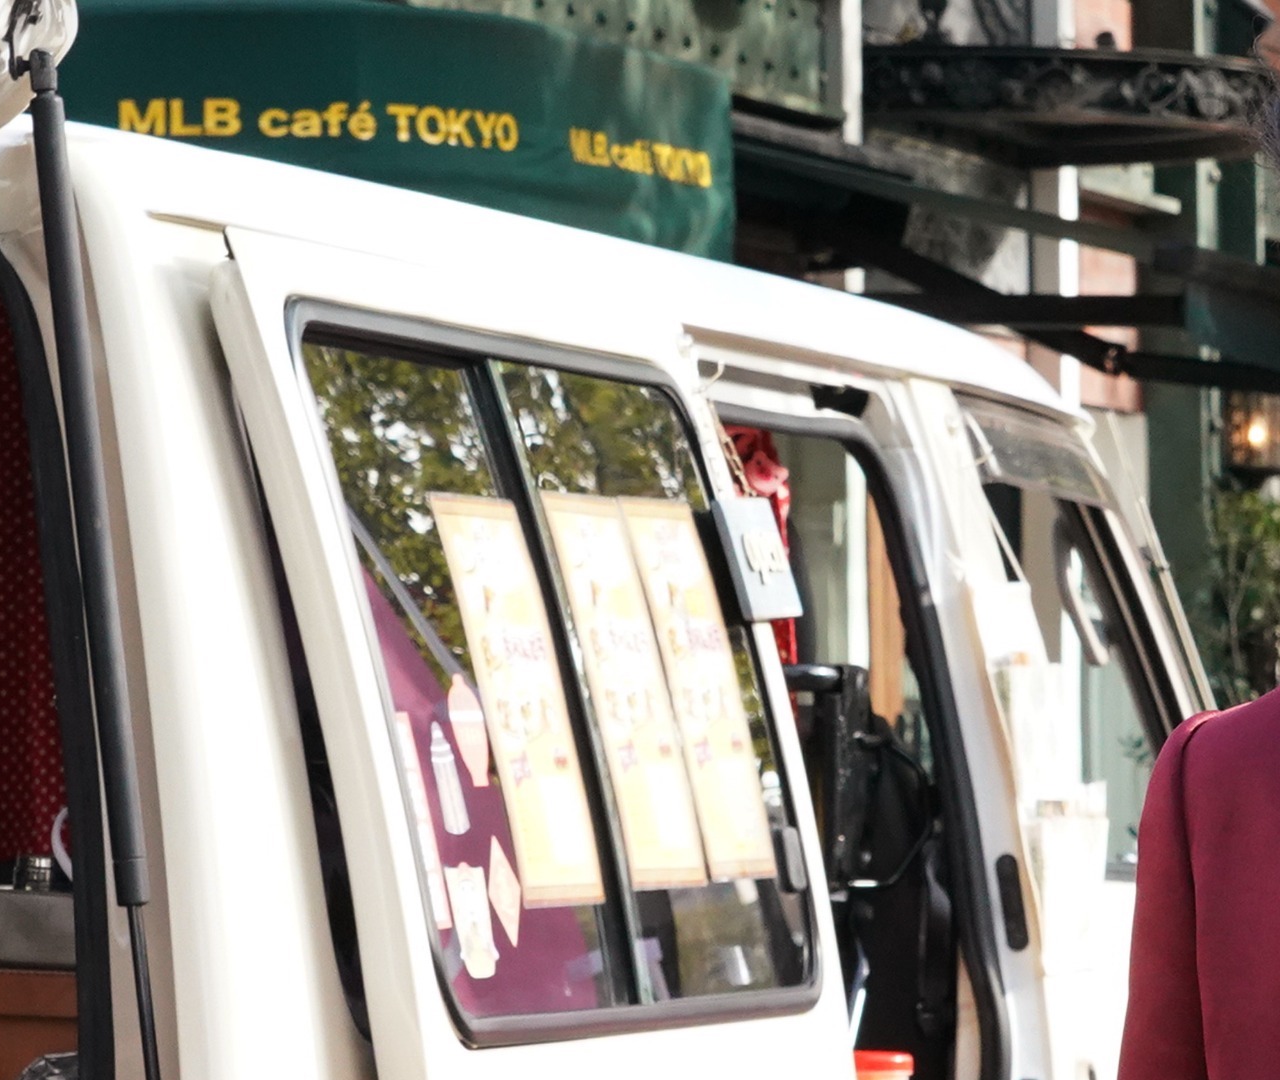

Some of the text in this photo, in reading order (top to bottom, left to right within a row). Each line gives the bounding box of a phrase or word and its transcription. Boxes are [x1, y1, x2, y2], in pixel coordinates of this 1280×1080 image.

[118, 97, 518, 152] MLB café TOKYO
